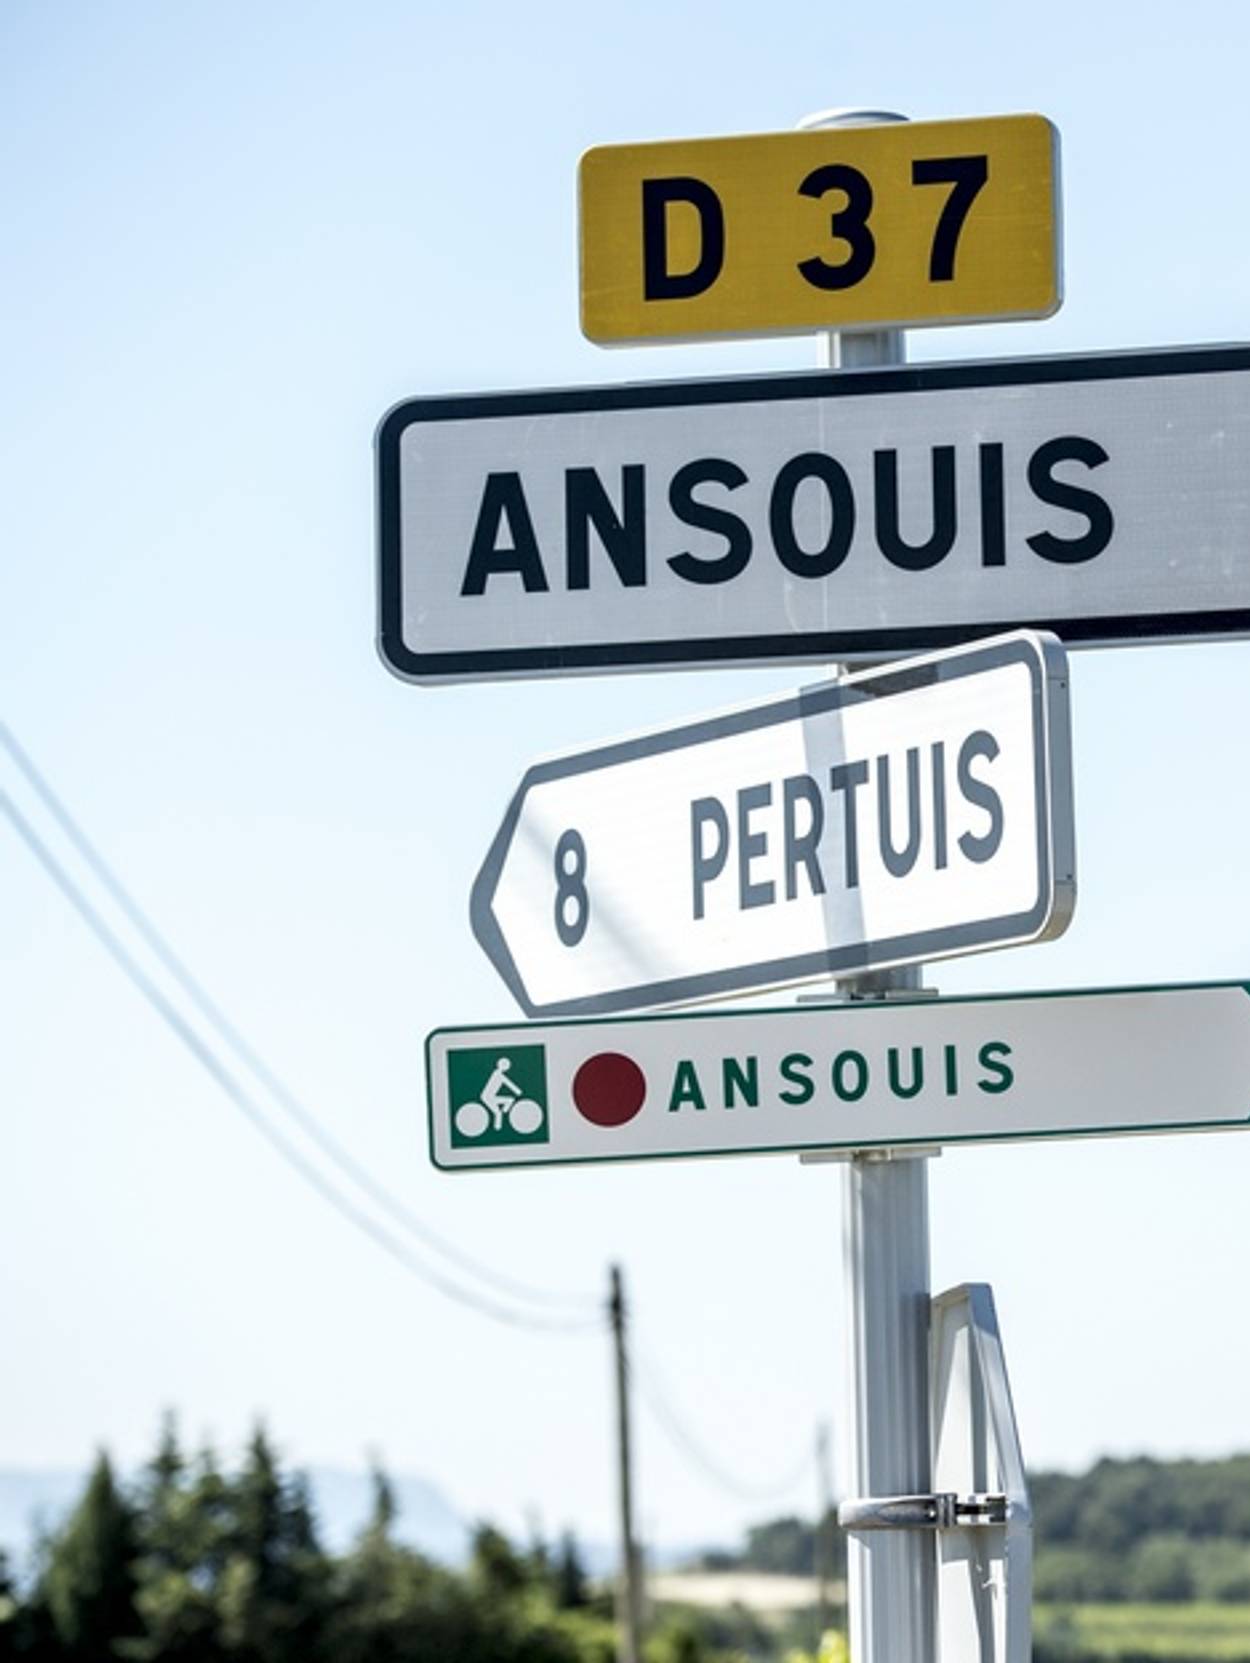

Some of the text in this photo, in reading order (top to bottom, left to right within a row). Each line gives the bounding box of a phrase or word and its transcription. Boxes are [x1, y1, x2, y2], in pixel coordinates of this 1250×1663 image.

[642, 155, 989, 301] D 37
[460, 436, 1115, 596] ANSOUIS
[554, 729, 1005, 948] 8 PERTUIS
[667, 1041, 1016, 1113] ANSOUIS
